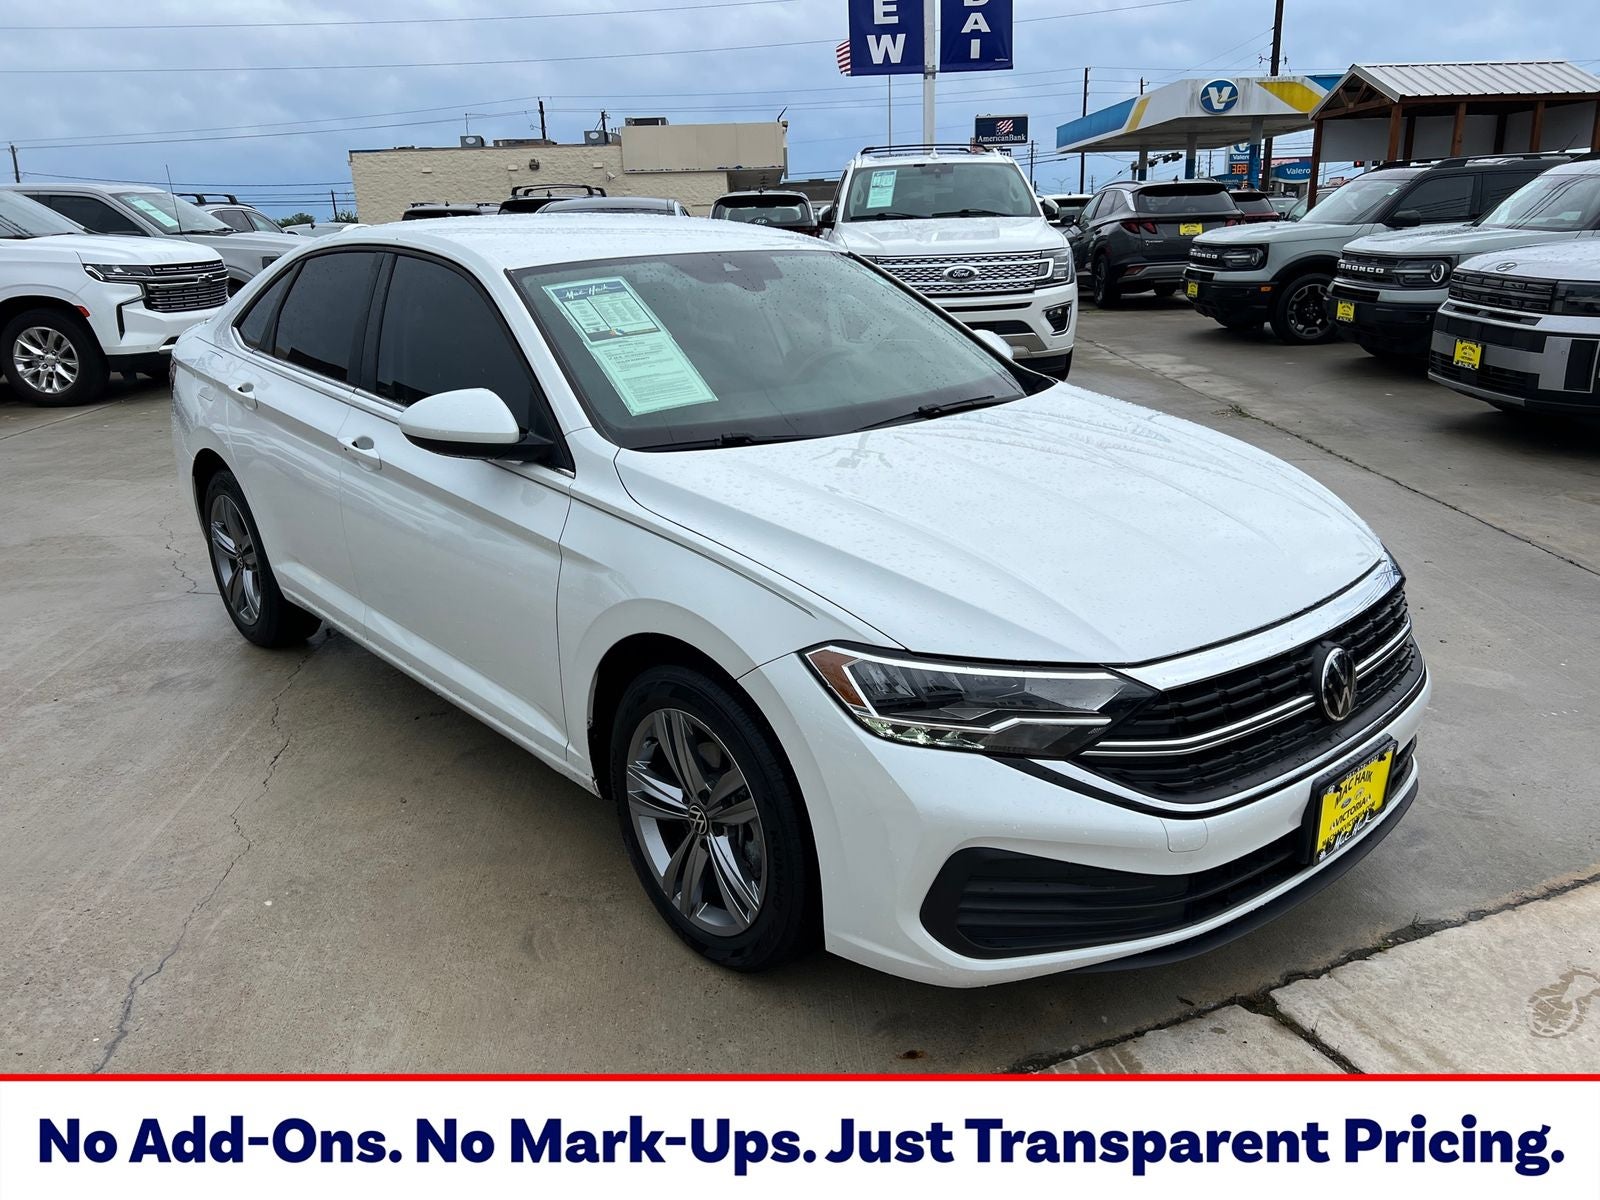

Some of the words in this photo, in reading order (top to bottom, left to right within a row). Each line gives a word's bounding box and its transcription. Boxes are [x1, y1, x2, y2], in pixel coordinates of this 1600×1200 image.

[977, 133, 1026, 143] AmericanBank
[1286, 167, 1311, 175] Valero
[952, 268, 970, 278] Ford
[1340, 263, 1385, 274] BRONCO
